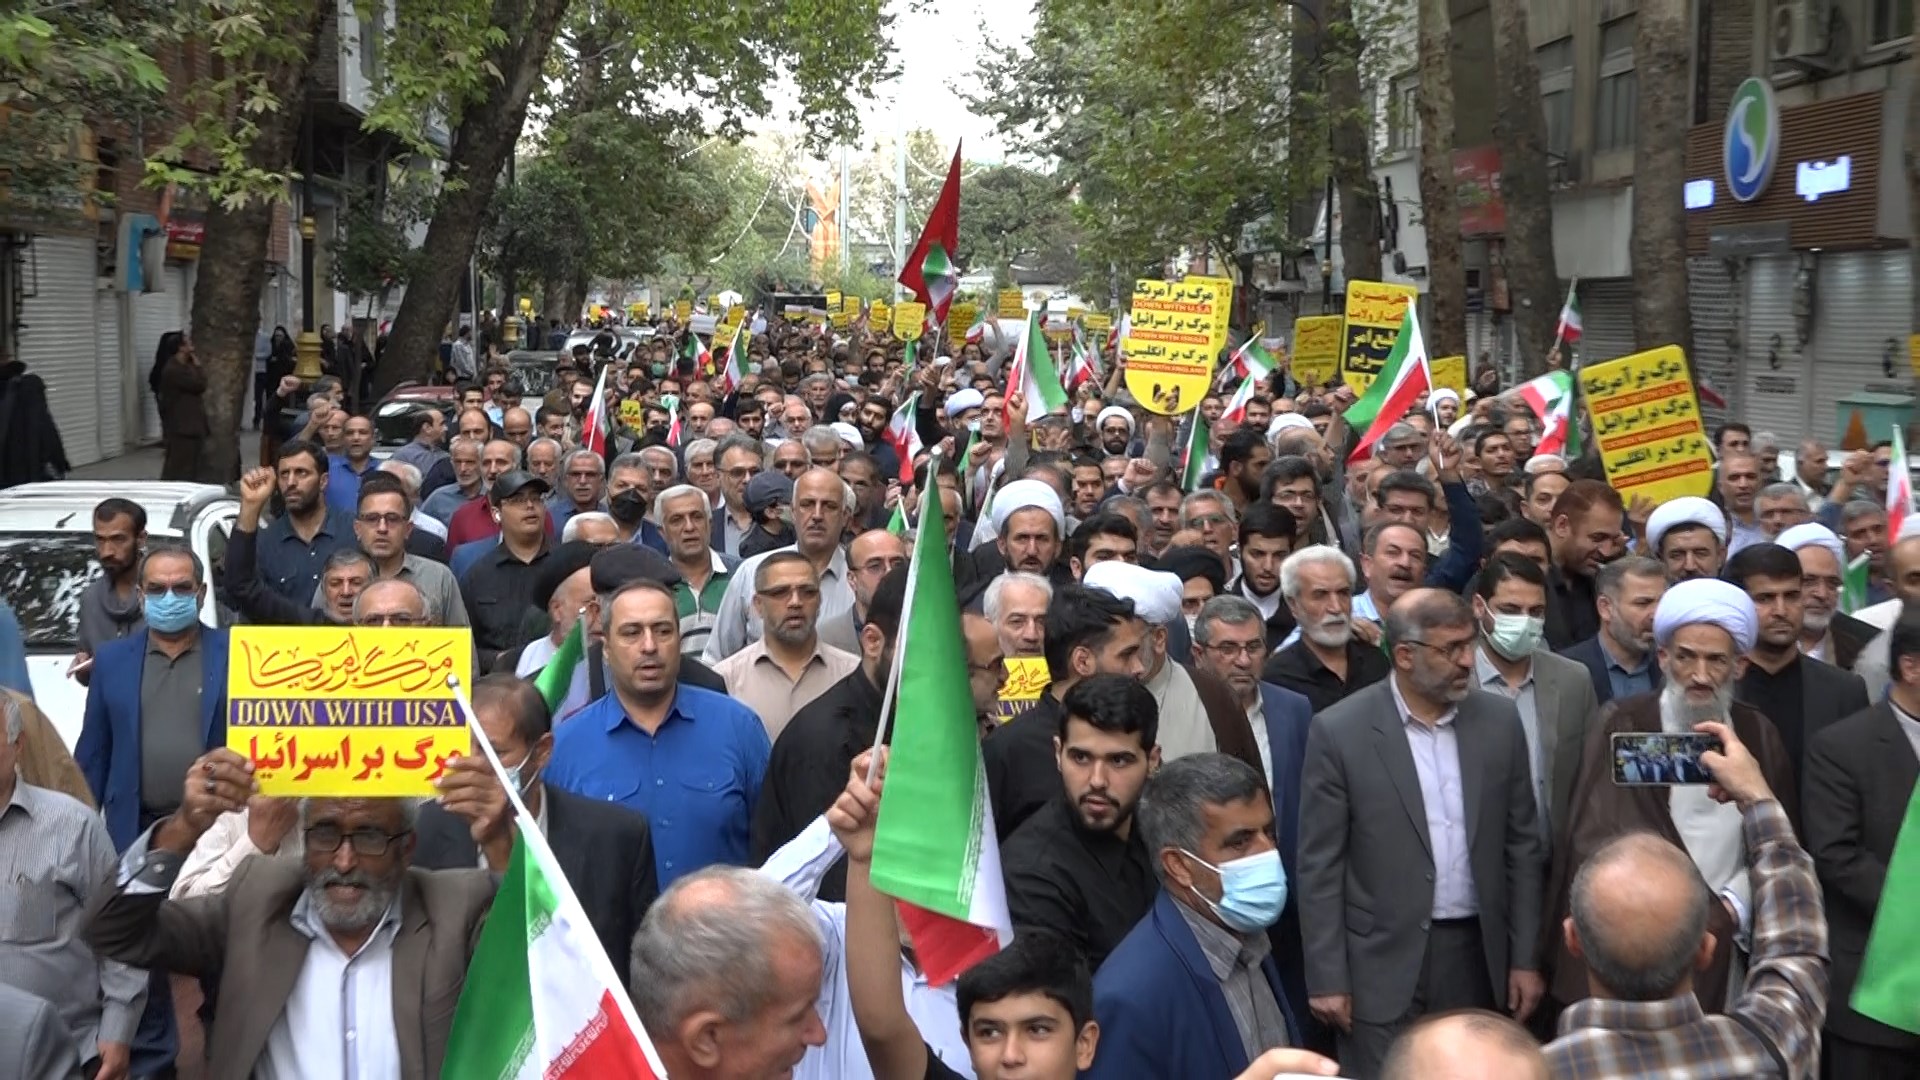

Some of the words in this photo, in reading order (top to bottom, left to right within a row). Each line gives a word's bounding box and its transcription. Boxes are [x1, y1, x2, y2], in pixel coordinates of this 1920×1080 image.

[237, 700, 316, 726] DOWN
[323, 700, 394, 726] WITH
[404, 700, 459, 726] USA
[352, 745, 385, 782] بر
